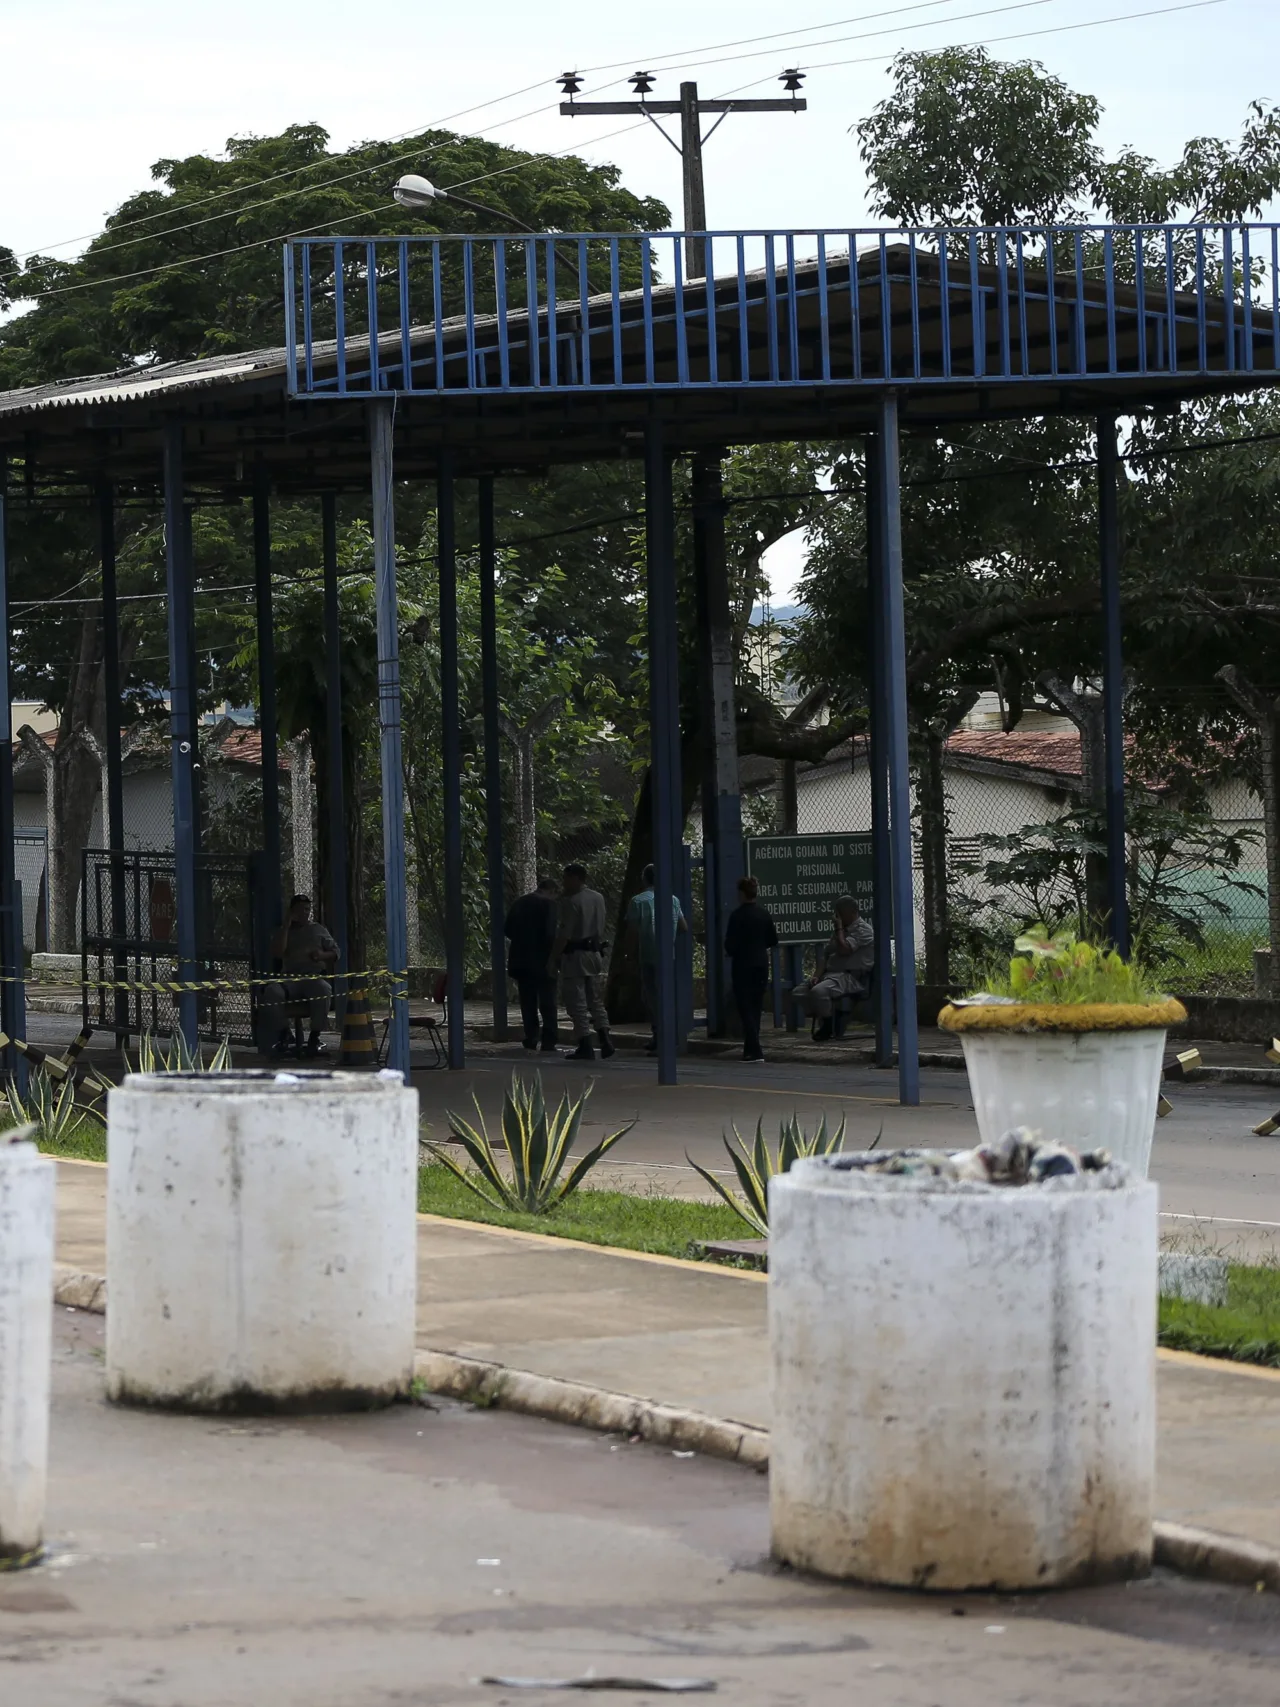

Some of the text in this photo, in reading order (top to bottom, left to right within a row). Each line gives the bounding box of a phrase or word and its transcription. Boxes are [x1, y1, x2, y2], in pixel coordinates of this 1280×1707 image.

[755, 843, 873, 860] AGÊNCIA GOIANA DO SISTE
[796, 863, 845, 877] PRISIONAL.
[782, 883, 793, 896] DE
[856, 880, 873, 893] PAR
[151, 902, 173, 919] PARE
[764, 900, 835, 915] DENTIFIQUE-SE,
